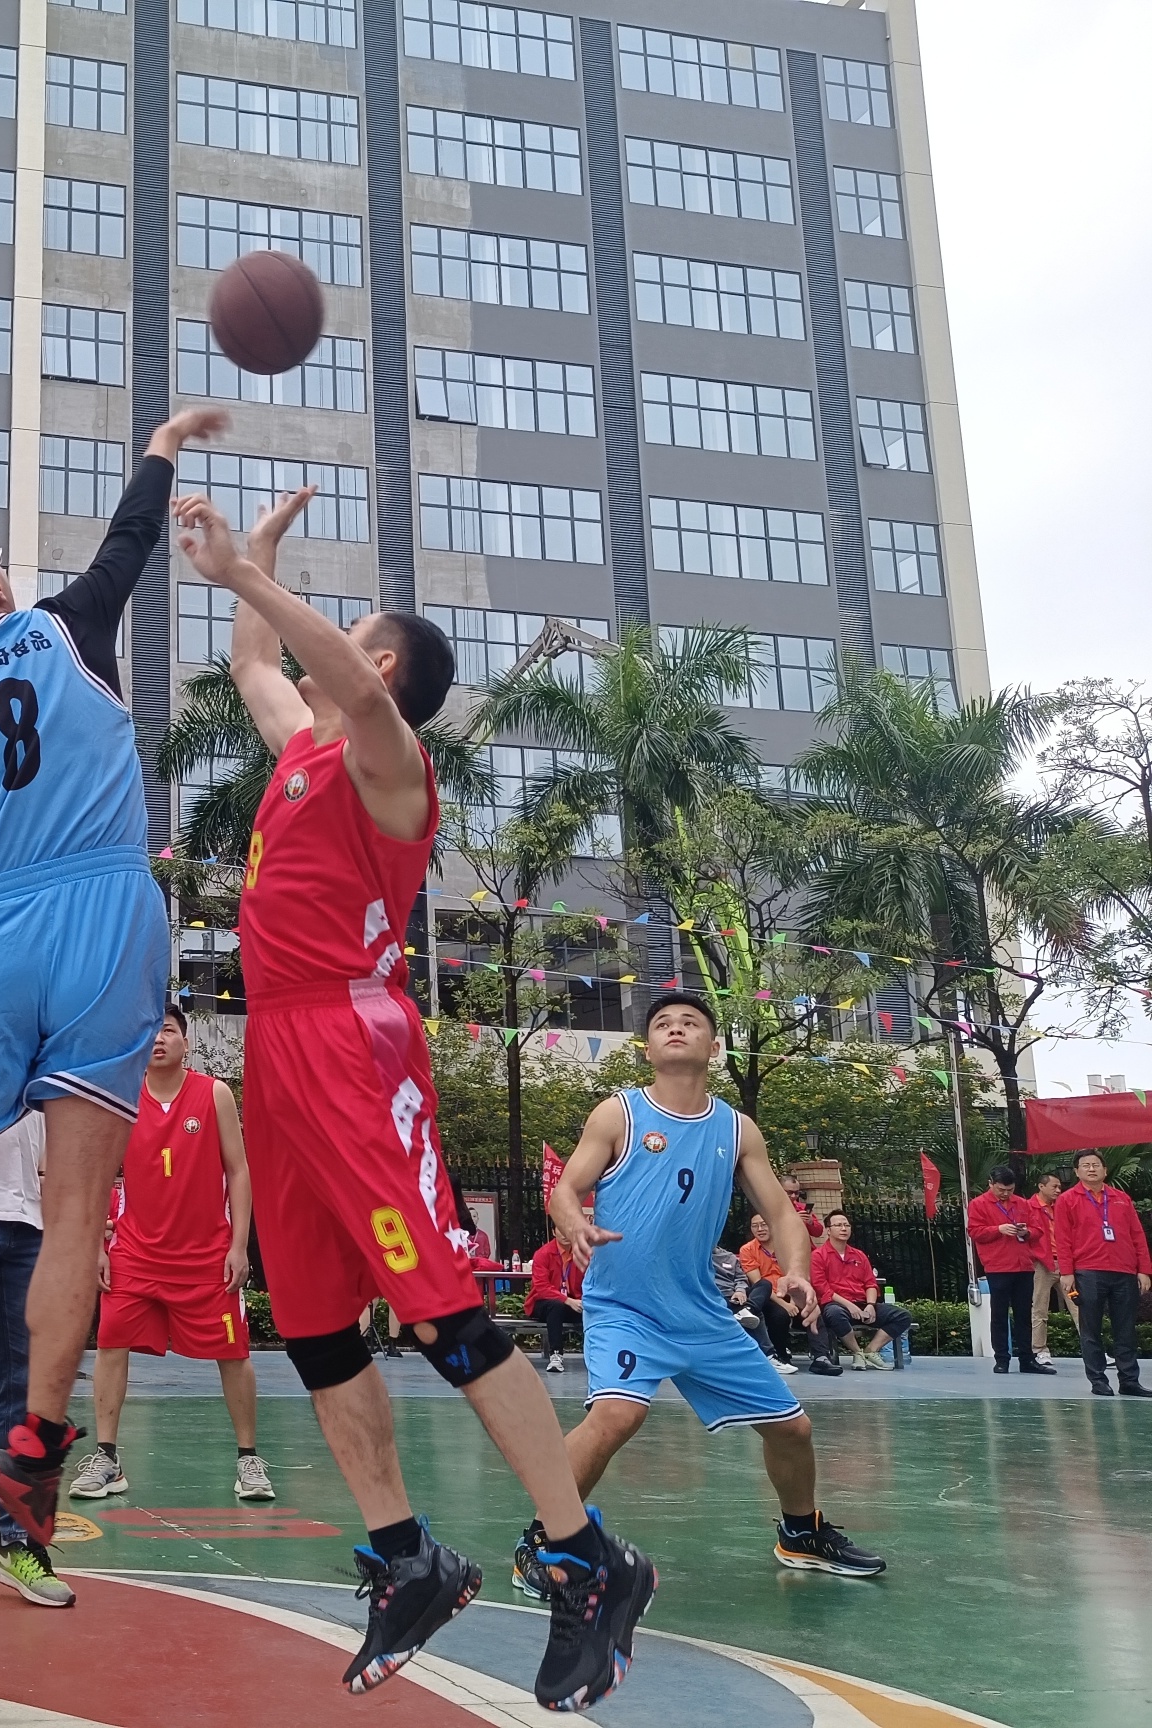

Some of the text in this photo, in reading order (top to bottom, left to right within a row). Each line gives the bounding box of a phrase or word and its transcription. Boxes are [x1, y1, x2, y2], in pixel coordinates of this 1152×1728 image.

[246, 830, 264, 890] 9
[160, 1147, 172, 1178] 1
[677, 1168, 694, 1204] 9
[370, 1205, 419, 1275] 9
[222, 1312, 236, 1344] 1
[616, 1349, 637, 1380] 9
